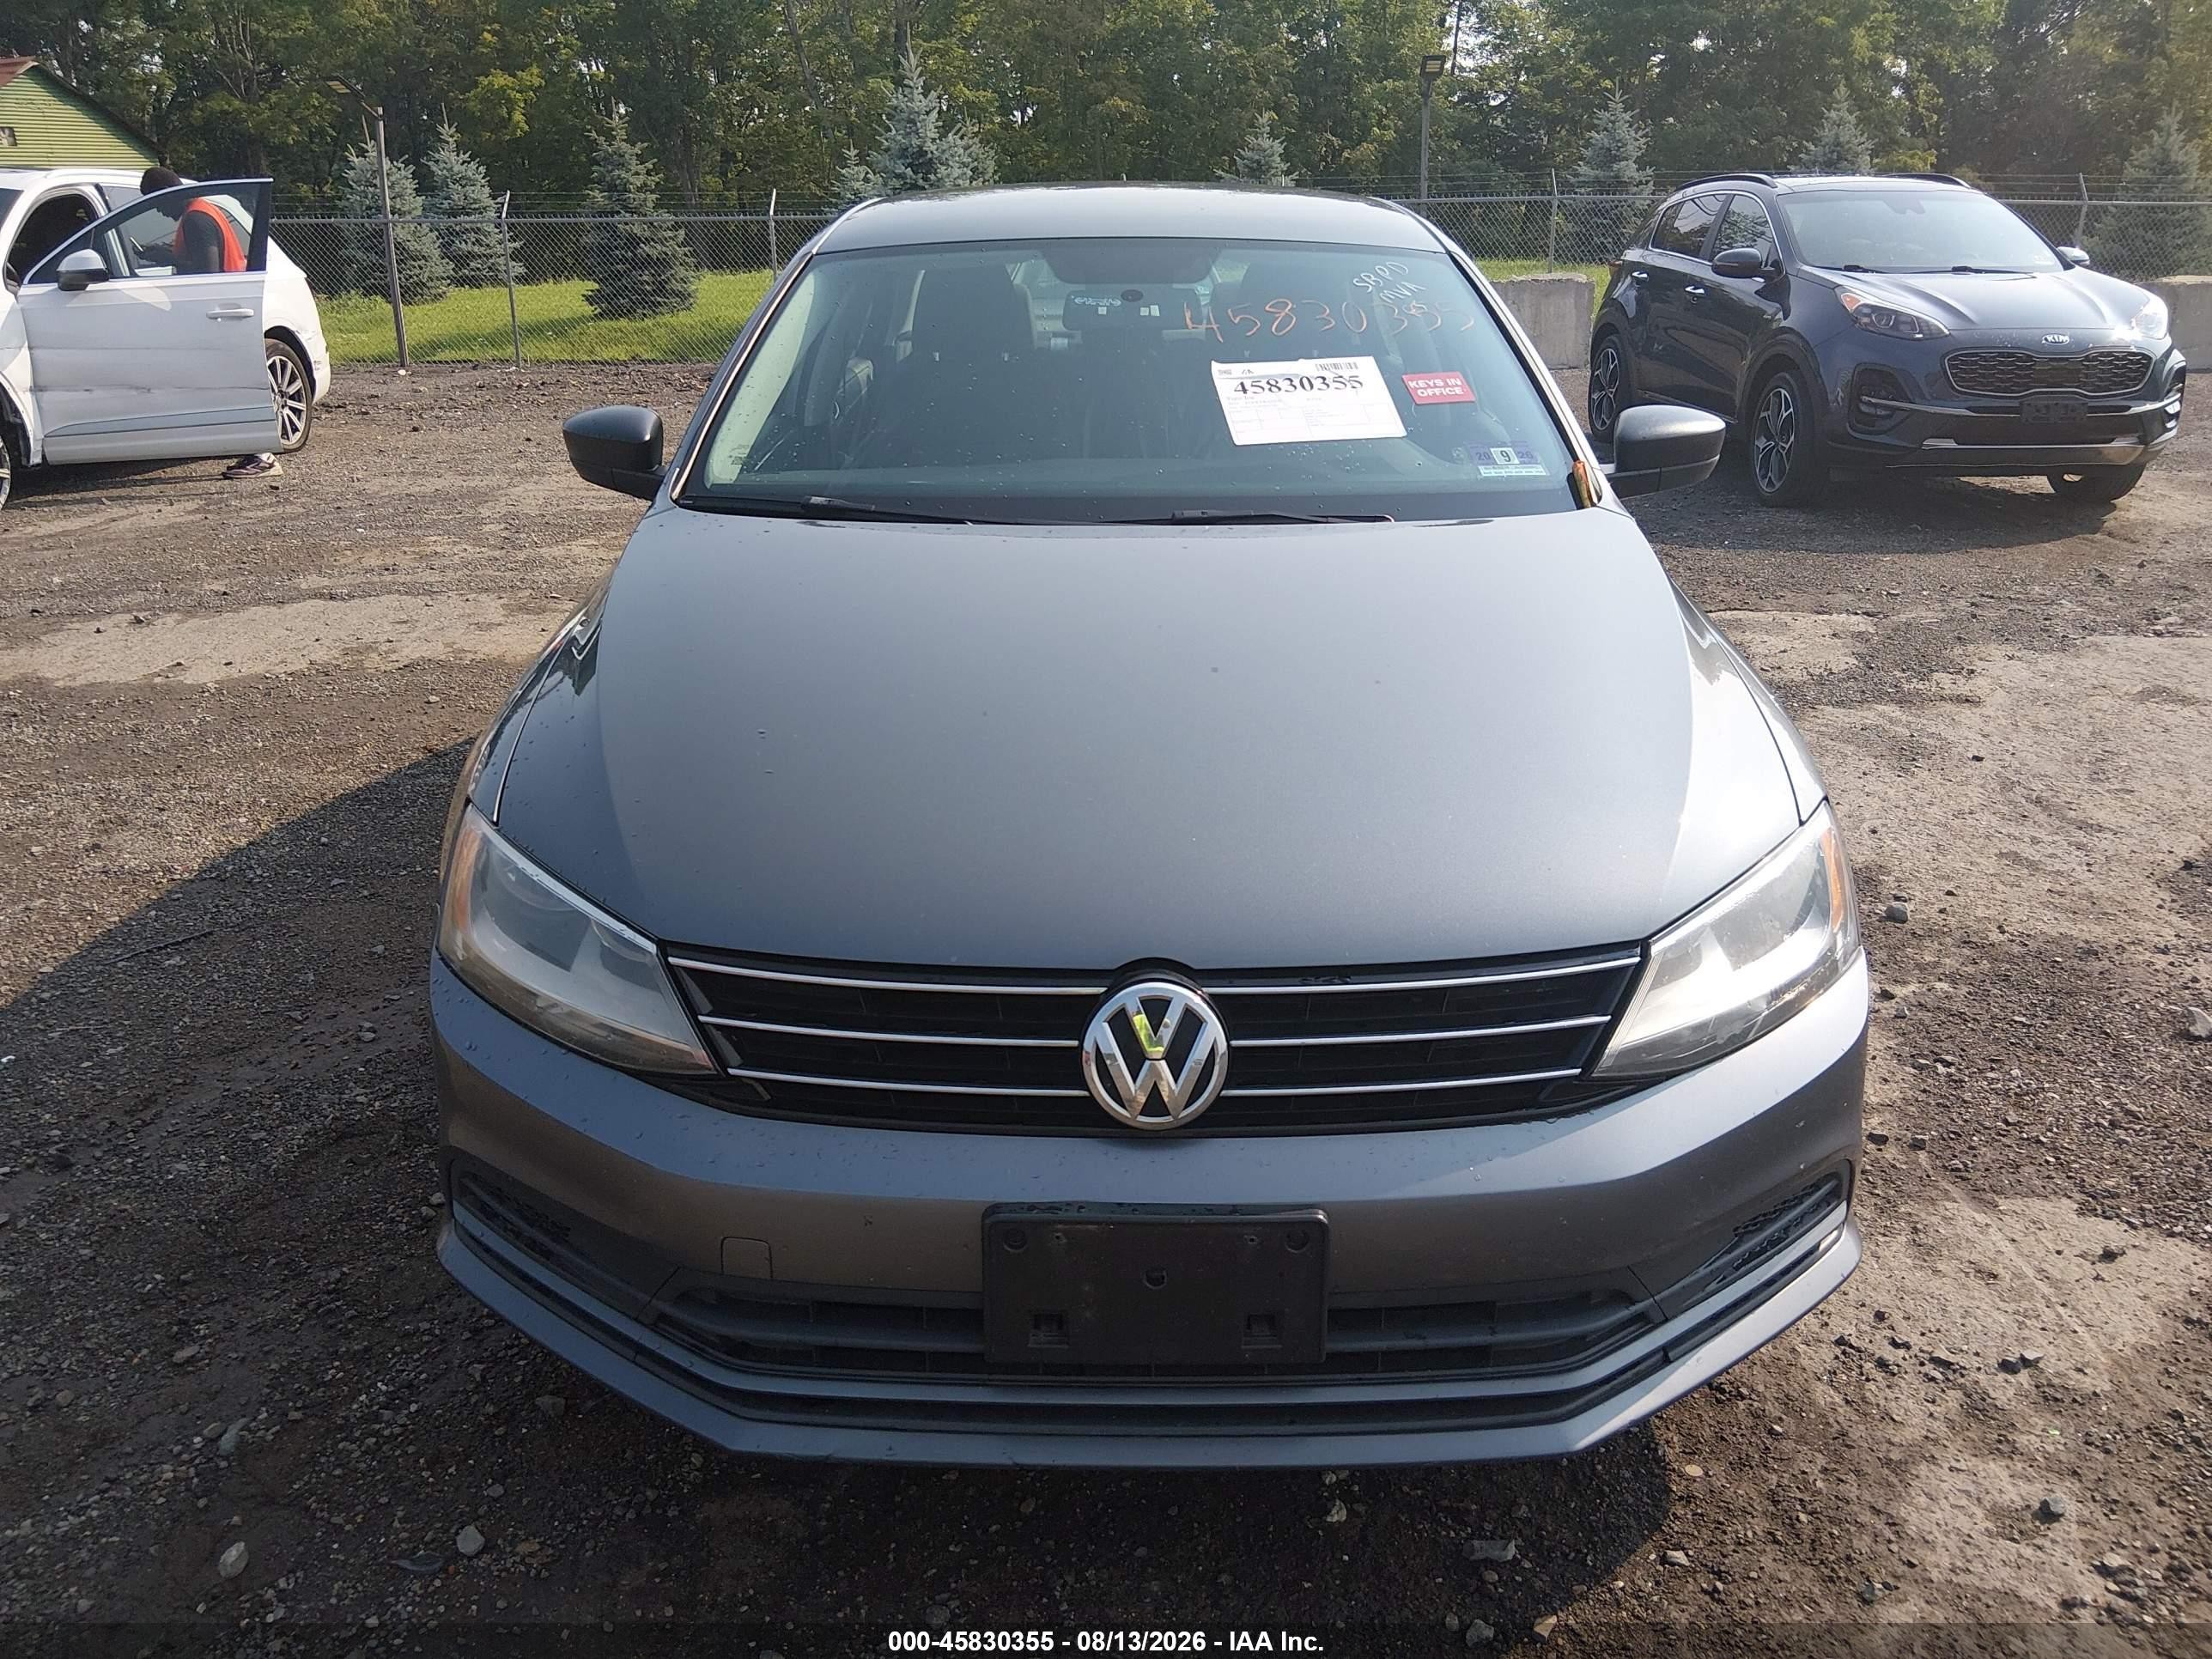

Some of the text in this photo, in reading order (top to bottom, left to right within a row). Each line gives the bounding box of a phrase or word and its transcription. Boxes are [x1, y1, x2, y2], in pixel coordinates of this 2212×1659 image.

[1234, 374, 1364, 394] 45830355
[1408, 377, 1462, 389] KEYS IN
[1417, 386, 1464, 397] OFFICE
[1500, 450, 1511, 463] 9
